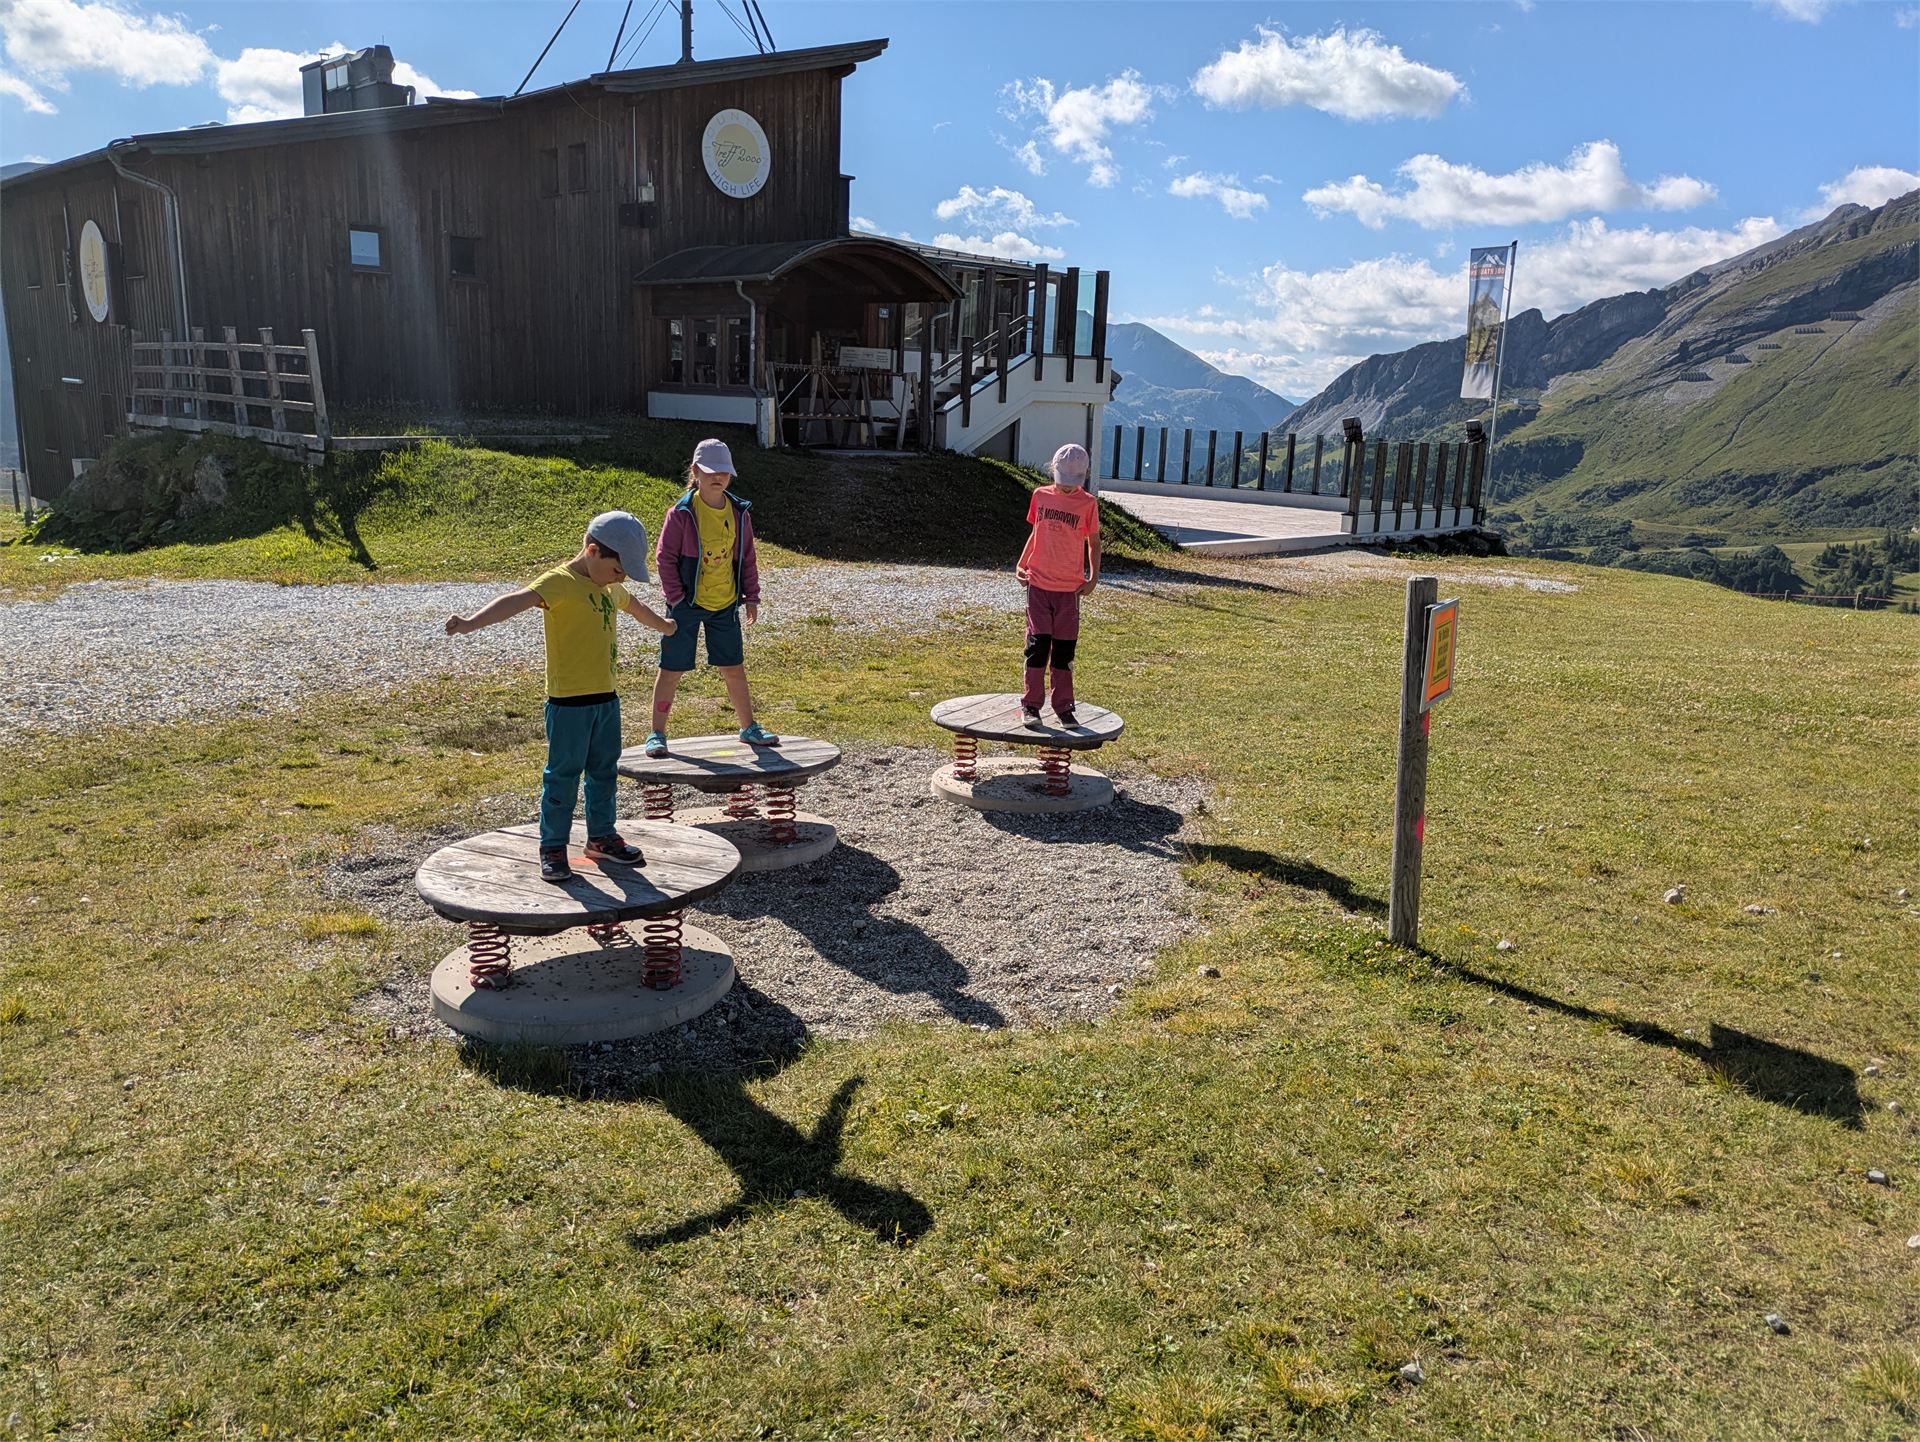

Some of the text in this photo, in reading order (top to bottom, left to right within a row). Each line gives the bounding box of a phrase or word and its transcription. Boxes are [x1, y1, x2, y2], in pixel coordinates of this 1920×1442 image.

[712, 141, 762, 167] Treff 2000
[711, 169, 762, 195] HIGH LIFE
[1044, 507, 1081, 530] MORAVANY
